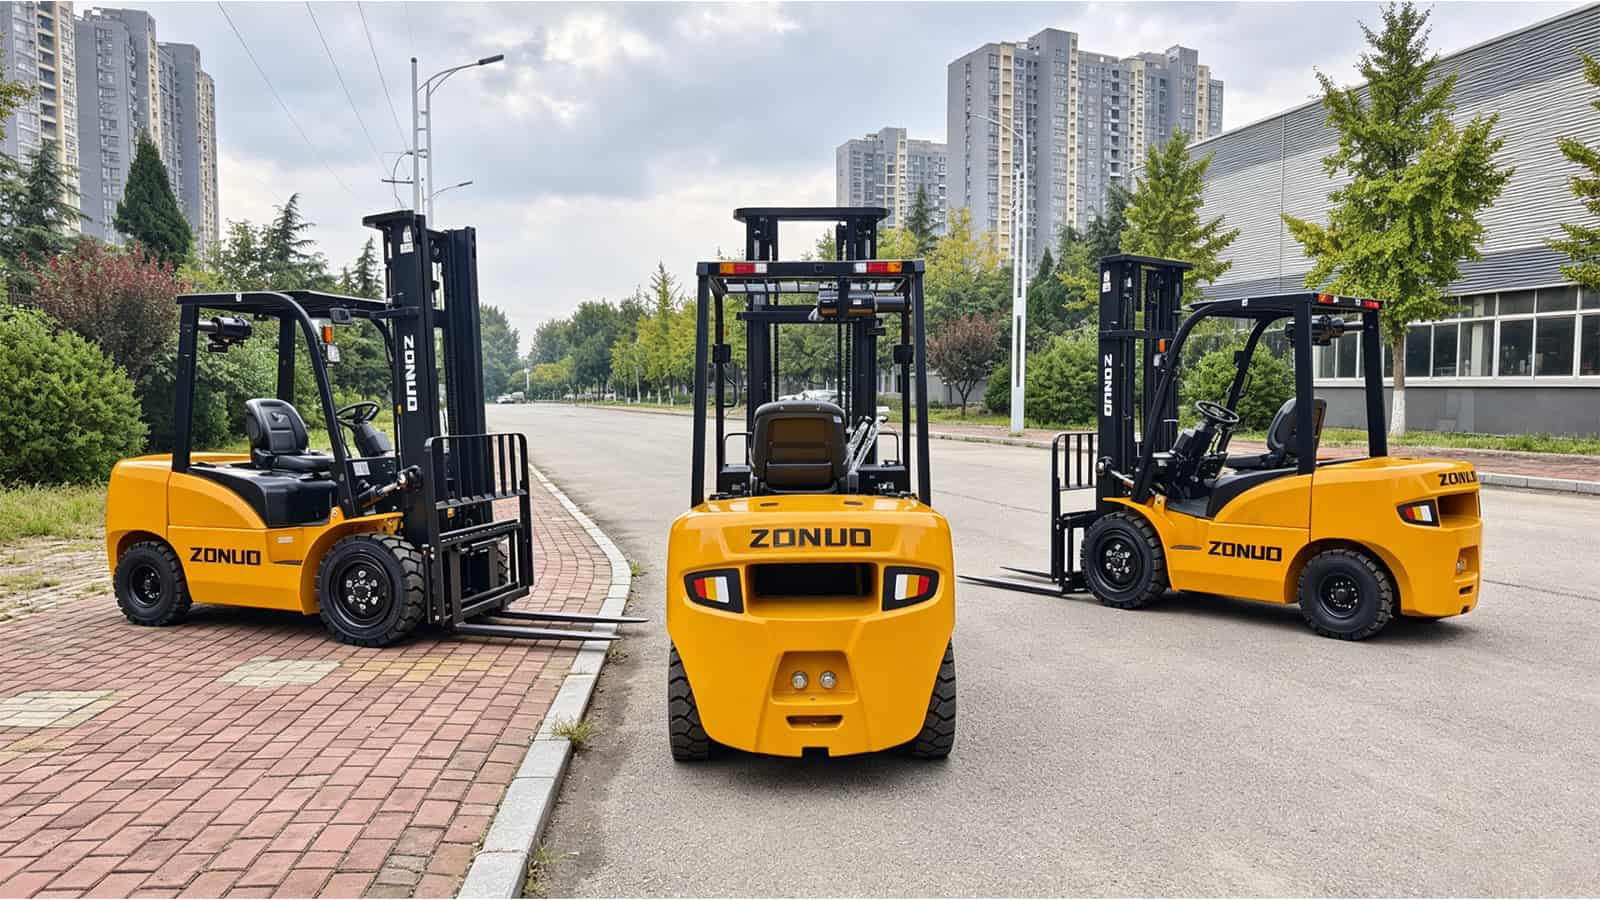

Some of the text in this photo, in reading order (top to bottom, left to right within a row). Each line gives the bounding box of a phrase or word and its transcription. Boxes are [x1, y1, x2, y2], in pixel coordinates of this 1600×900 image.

[404, 335, 417, 411] ZONUO
[1104, 354, 1112, 416] ZONUO
[750, 528, 871, 547] ZONUO
[190, 547, 261, 565] ZONUO
[1208, 541, 1282, 562] ZONUO
